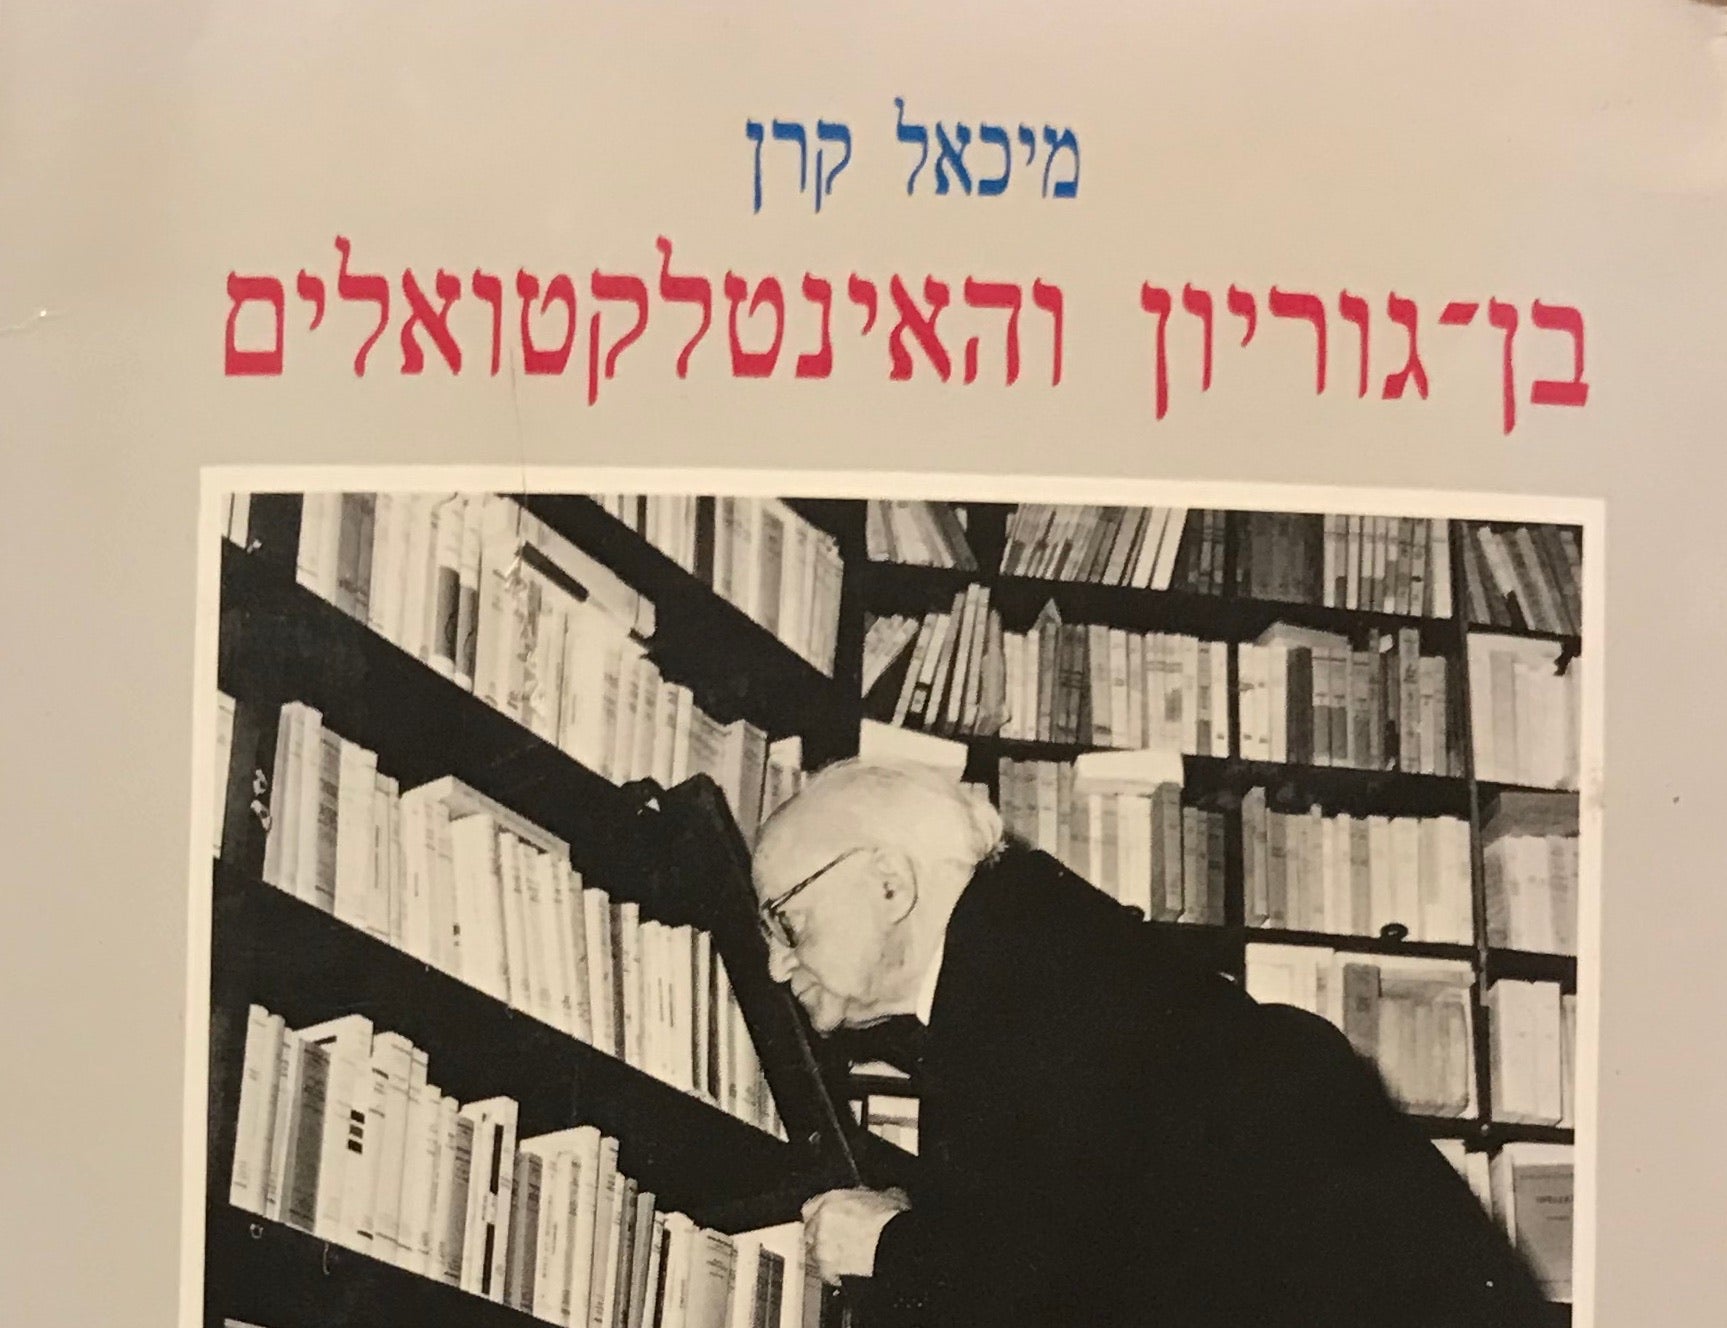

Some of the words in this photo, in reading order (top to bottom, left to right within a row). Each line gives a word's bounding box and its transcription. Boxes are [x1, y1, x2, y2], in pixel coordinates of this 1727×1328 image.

[746, 119, 853, 212] קרן
[896, 98, 1080, 199] מיכאל
[223, 236, 1065, 405] והאינטלקטואלים
[1140, 280, 1590, 434] בן־גוריון
